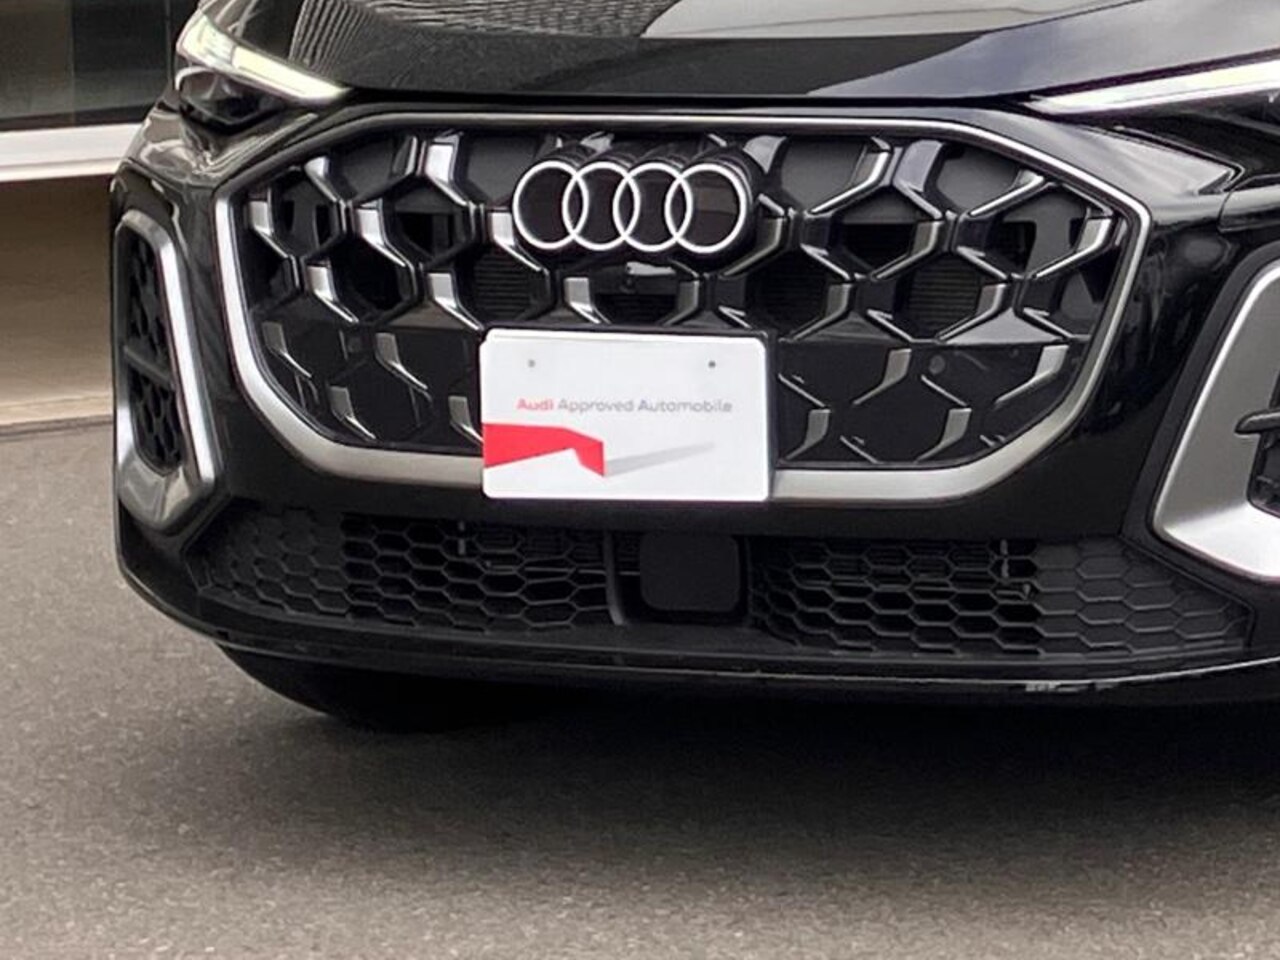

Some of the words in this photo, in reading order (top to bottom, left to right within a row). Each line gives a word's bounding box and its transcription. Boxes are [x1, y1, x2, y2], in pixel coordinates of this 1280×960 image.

[516, 398, 554, 411] Audi
[557, 398, 634, 414] Approved
[638, 398, 733, 414] Automobile
